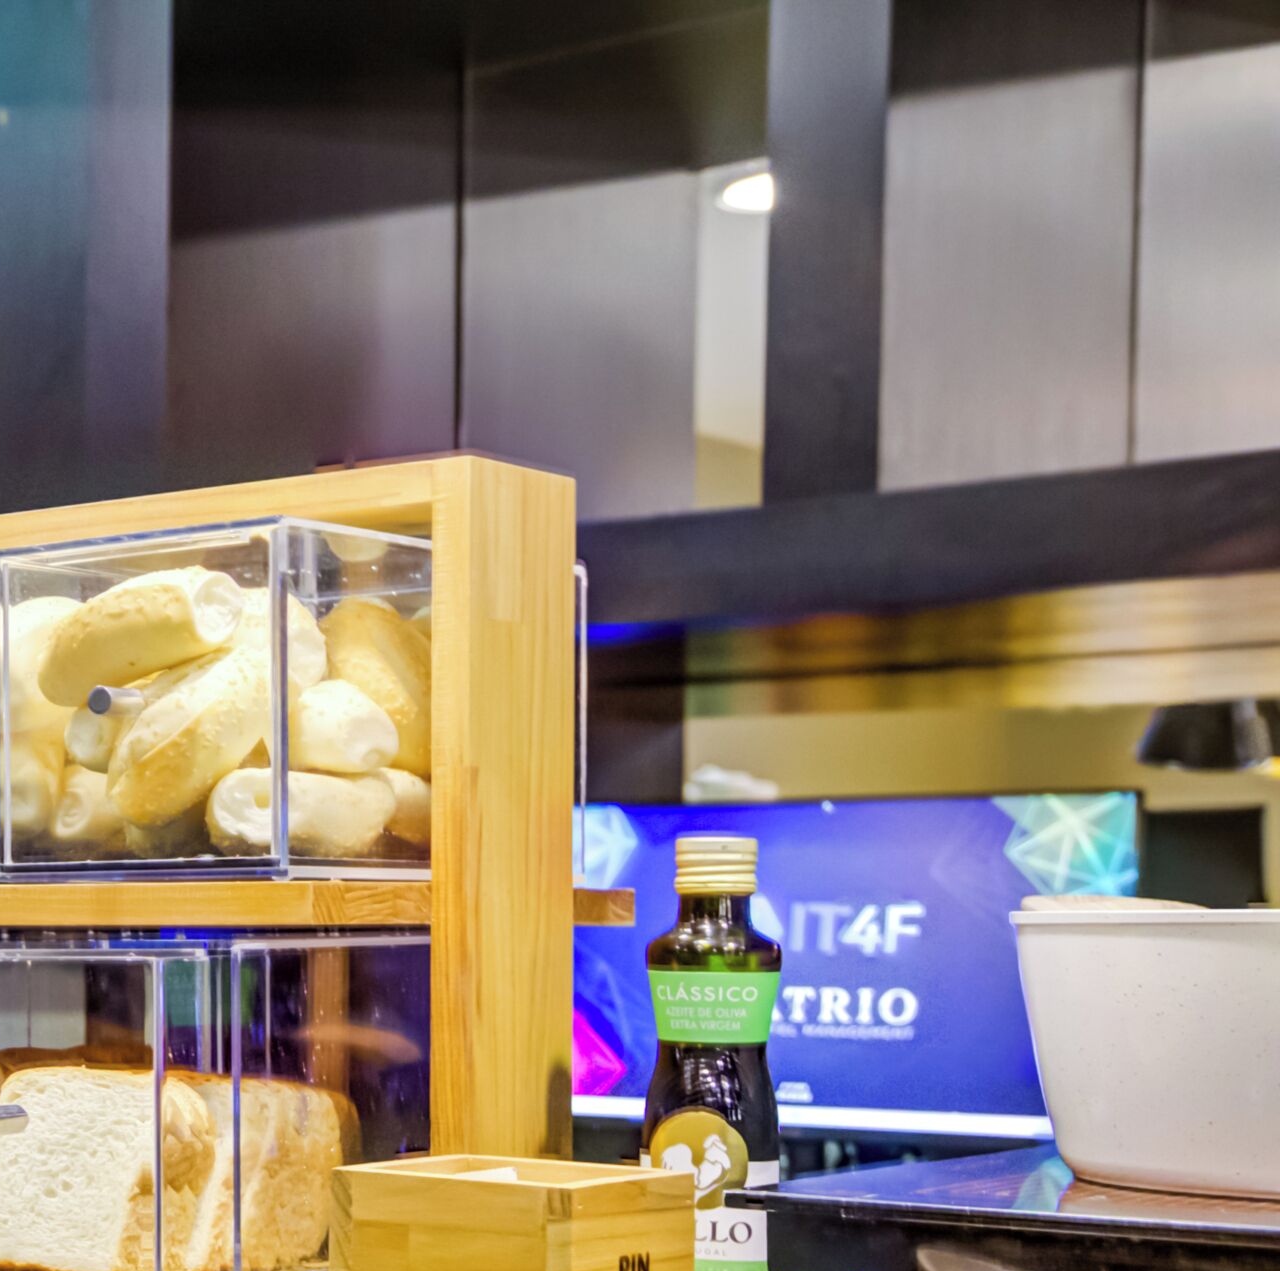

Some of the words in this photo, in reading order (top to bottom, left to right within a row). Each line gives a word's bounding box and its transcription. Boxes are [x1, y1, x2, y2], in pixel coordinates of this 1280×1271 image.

[657, 981, 758, 1002] CLÁSSICO
[697, 1007, 712, 1018] DE
[715, 1007, 747, 1018] OLIVA
